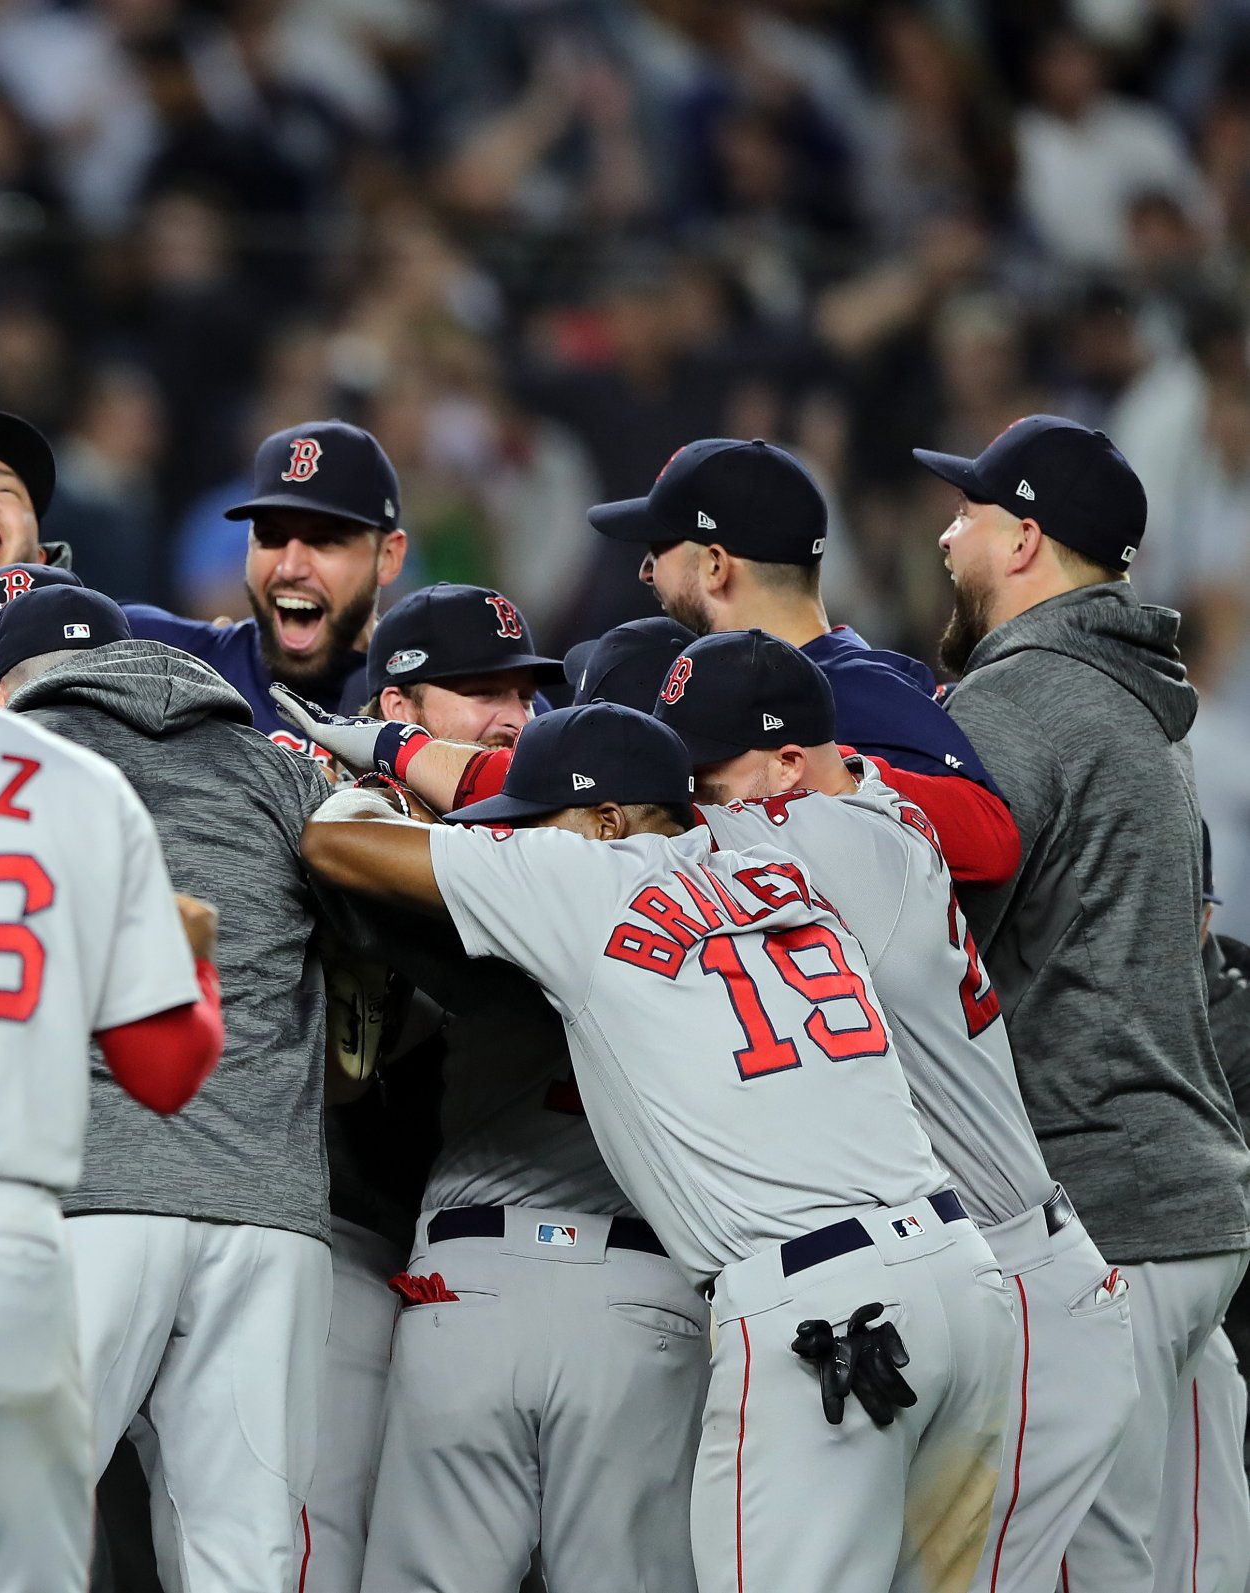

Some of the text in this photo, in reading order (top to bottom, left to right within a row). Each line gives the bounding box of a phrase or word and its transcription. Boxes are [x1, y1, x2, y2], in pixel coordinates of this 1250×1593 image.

[281, 438, 323, 482] B
[0, 568, 35, 610] B
[485, 597, 522, 639] B
[660, 655, 693, 705] B
[698, 922, 890, 1082] 19
